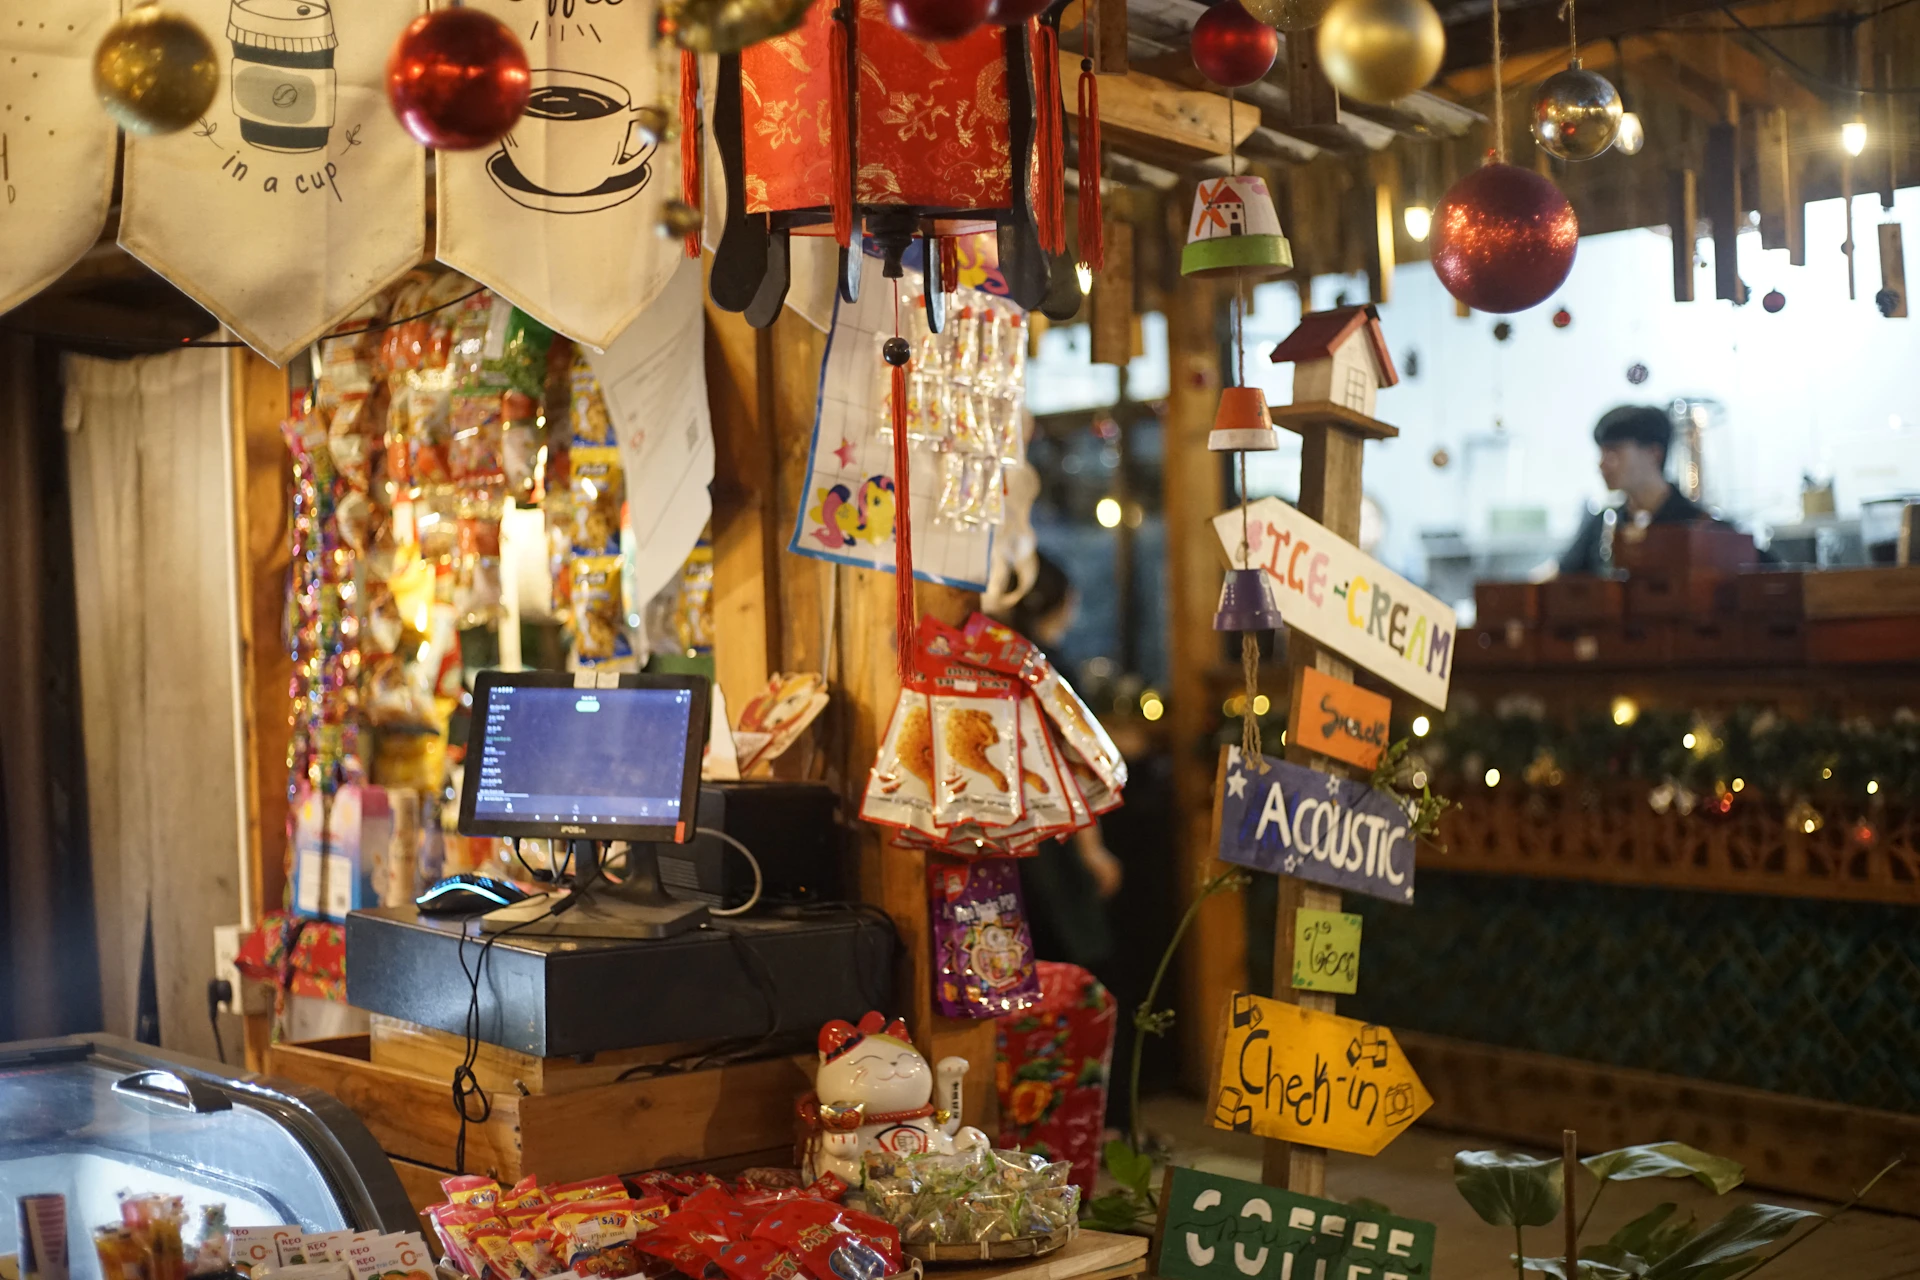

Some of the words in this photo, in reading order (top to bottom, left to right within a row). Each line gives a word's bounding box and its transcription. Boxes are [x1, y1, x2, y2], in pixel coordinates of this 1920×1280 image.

[222, 150, 248, 181] in
[264, 176, 278, 193] a
[295, 162, 342, 202] cup
[1239, 1029, 1379, 1127] Check-in
[281, 1237, 301, 1246] KẸO
[307, 1241, 327, 1251] KẸO
[350, 1246, 370, 1256] KẸO
[356, 1256, 376, 1266] KẸO
